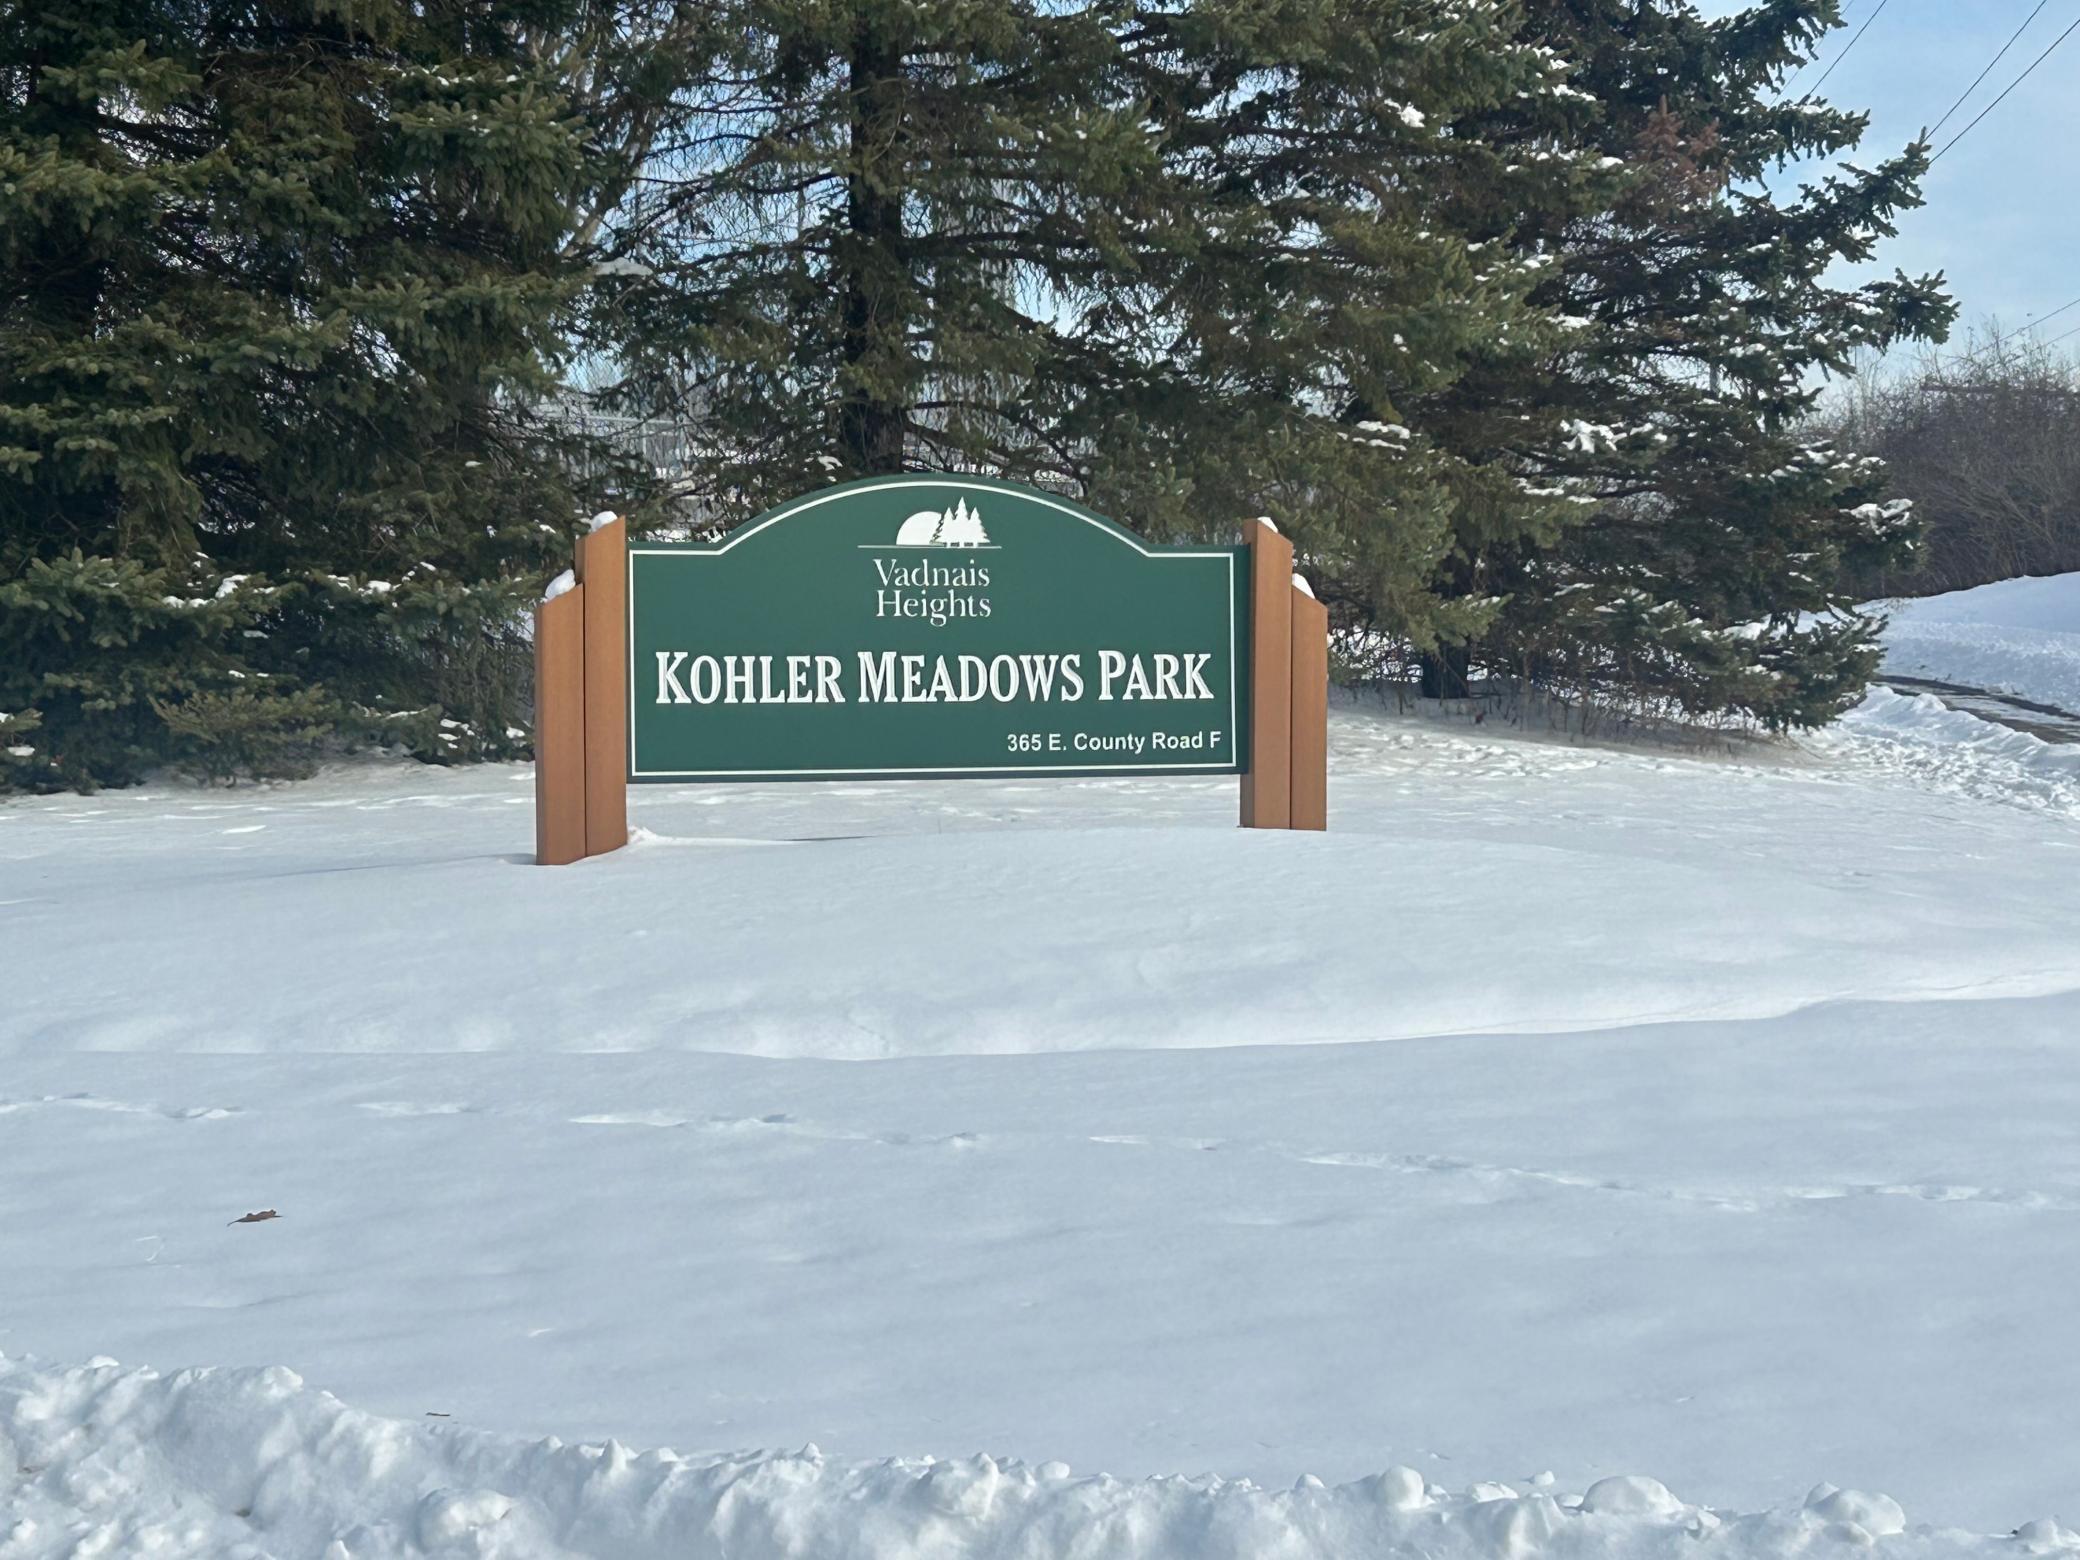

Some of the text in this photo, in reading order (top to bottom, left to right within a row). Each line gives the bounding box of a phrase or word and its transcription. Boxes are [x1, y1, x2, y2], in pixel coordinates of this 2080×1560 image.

[873, 558, 990, 587] Vadnais
[876, 588, 992, 627] Heights
[655, 650, 1215, 705] KOHLER MEADOWS PARK
[1007, 730, 1222, 755] 365 E. County Road F
